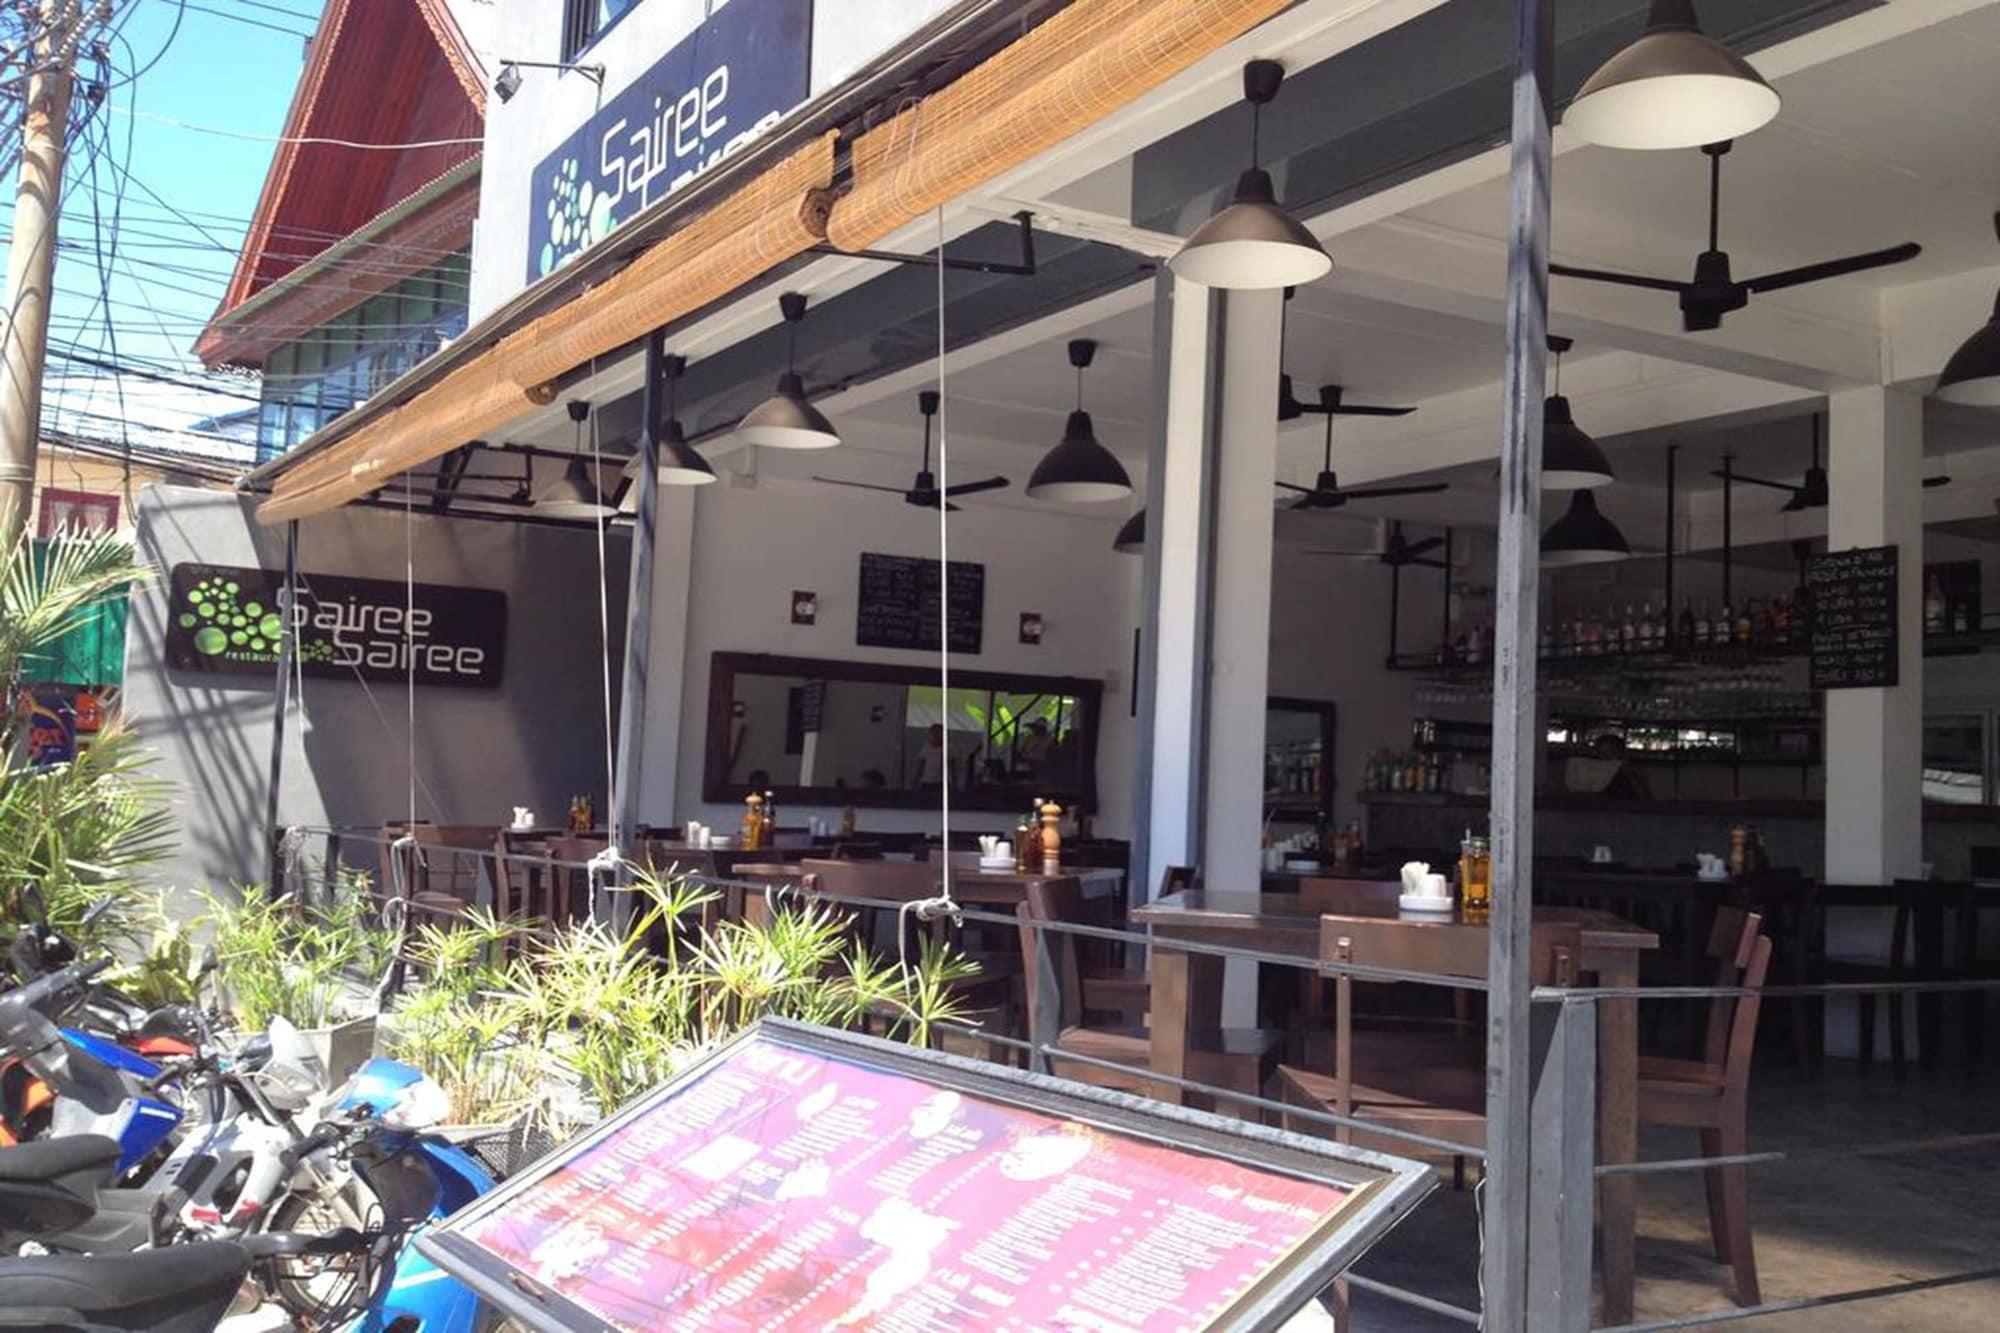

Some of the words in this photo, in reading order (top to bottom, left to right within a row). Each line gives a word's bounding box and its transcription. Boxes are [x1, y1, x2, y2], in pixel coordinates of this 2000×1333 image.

[601, 64, 729, 208] Sairee
[276, 586, 432, 637] Sairee
[332, 628, 485, 674] Sairee
